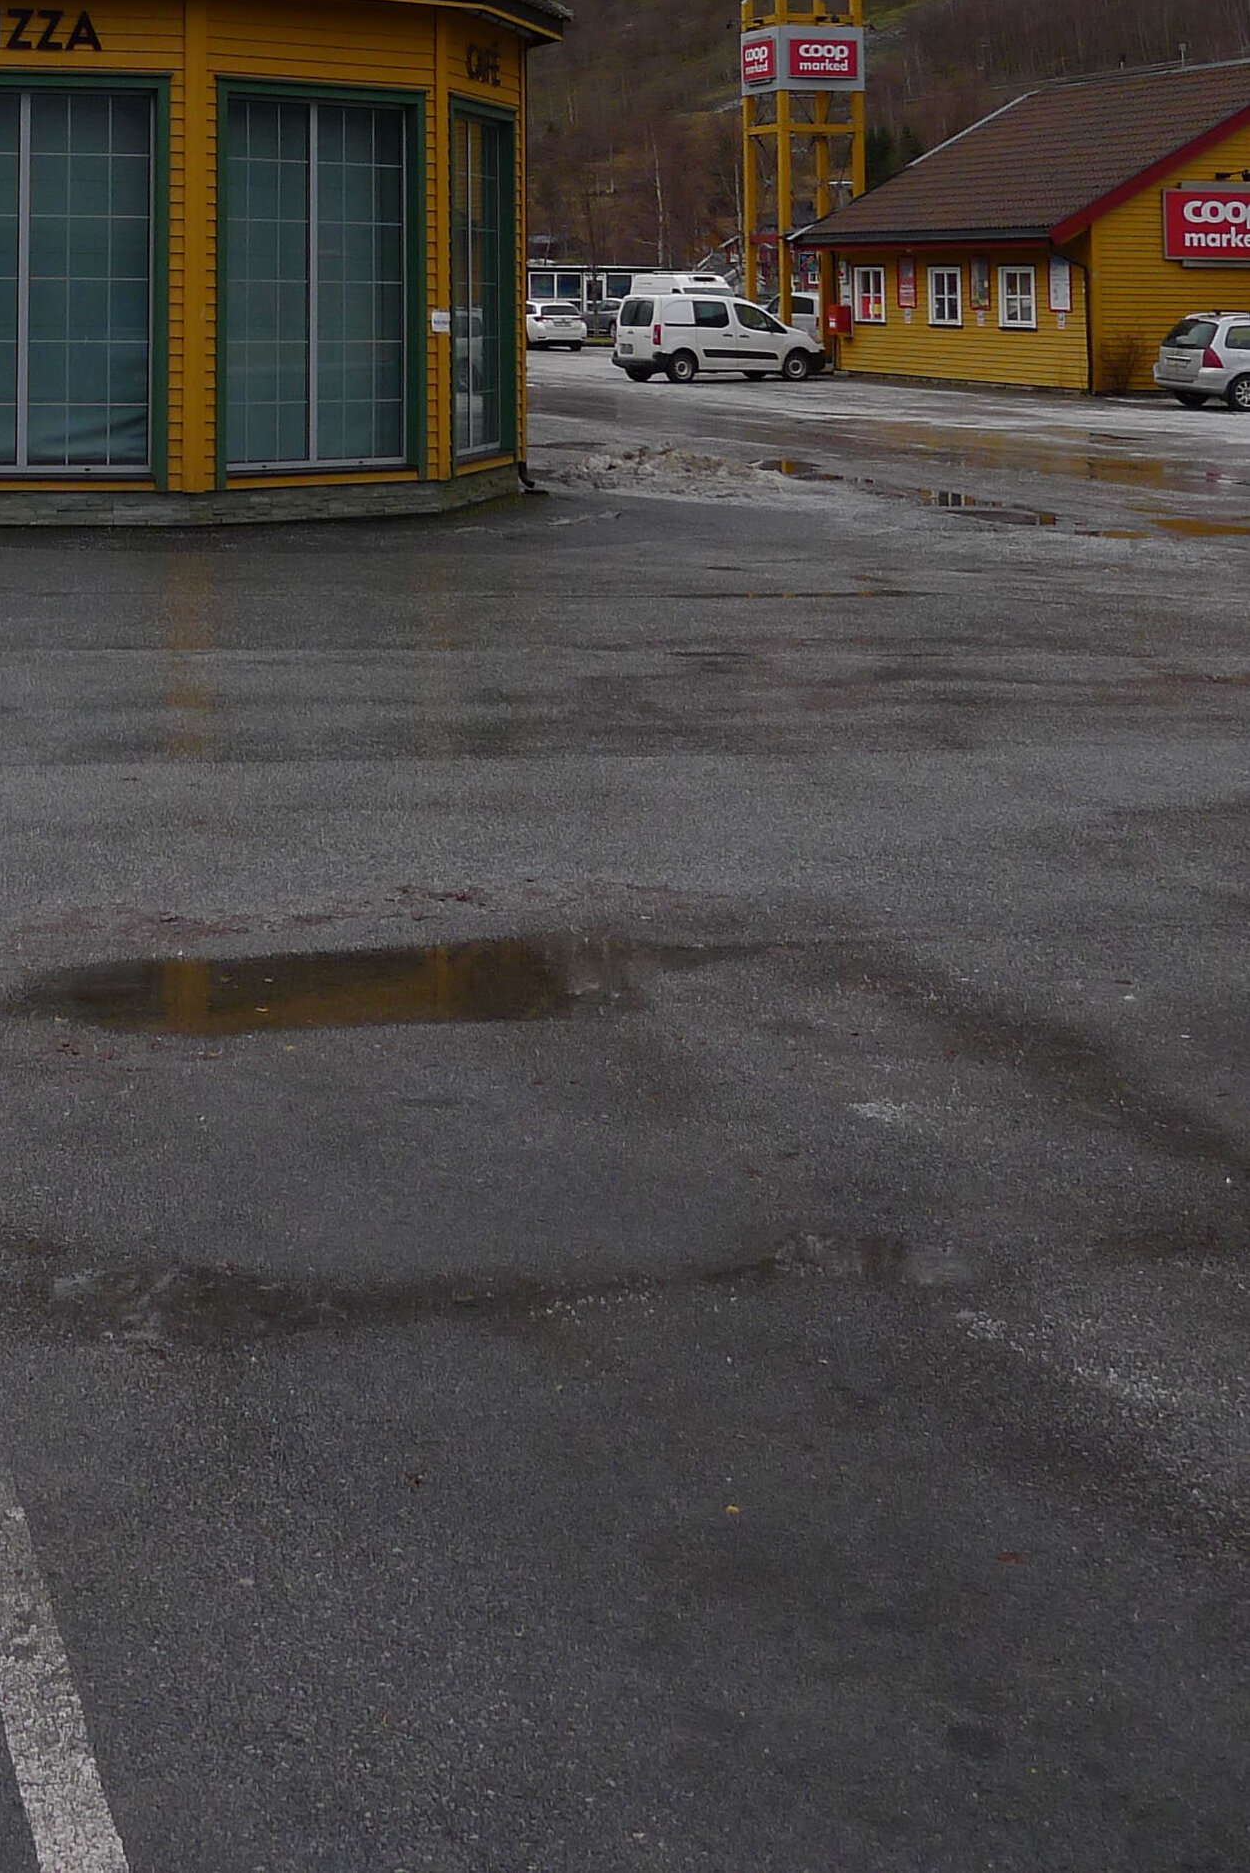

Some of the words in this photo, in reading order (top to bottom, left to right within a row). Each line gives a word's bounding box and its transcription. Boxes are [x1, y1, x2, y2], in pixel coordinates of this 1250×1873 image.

[799, 44, 849, 61] coop
[799, 59, 848, 72] marked
[1183, 200, 1250, 230] coo
